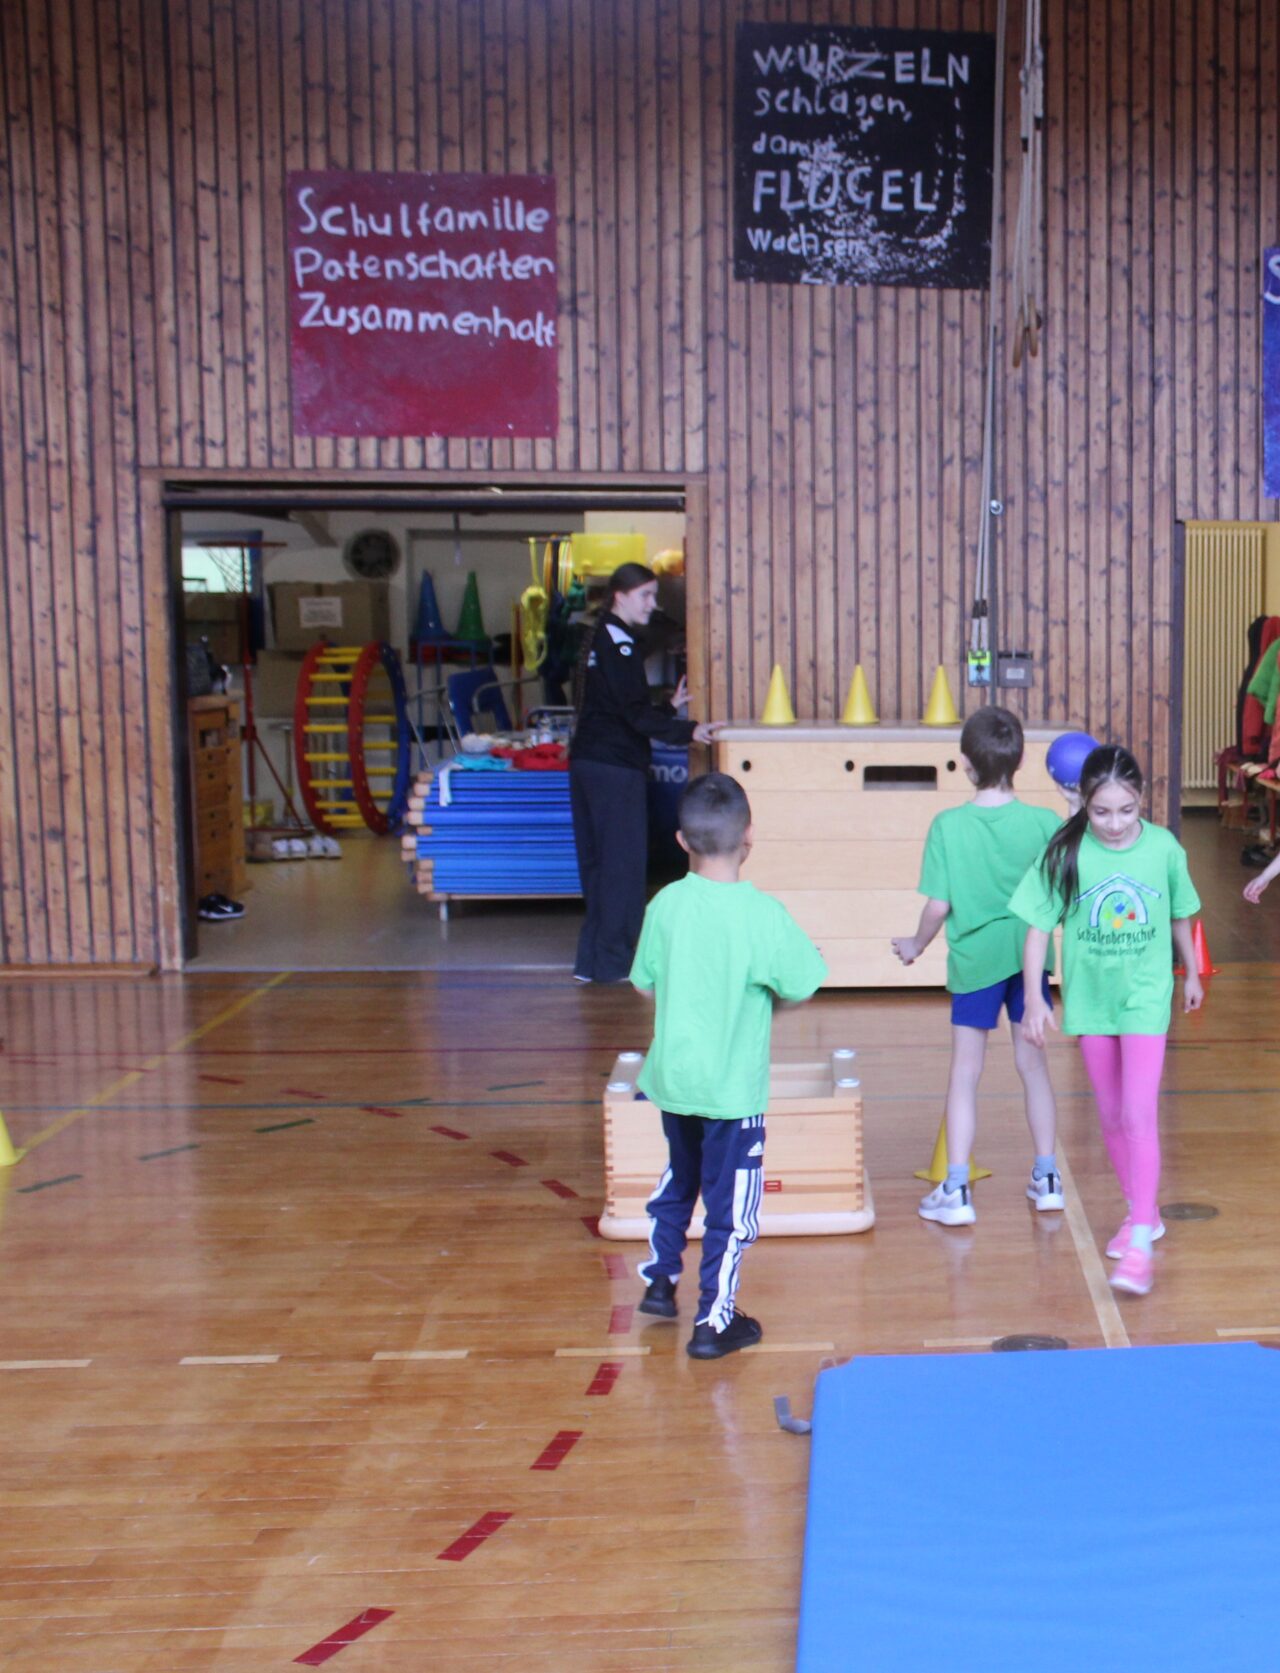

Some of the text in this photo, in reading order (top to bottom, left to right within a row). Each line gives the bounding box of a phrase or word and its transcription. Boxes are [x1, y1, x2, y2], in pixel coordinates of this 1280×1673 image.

[752, 44, 970, 88] WURZELN
[294, 246, 554, 288] Patenschaften
[299, 292, 556, 347] Zusammenhalt
